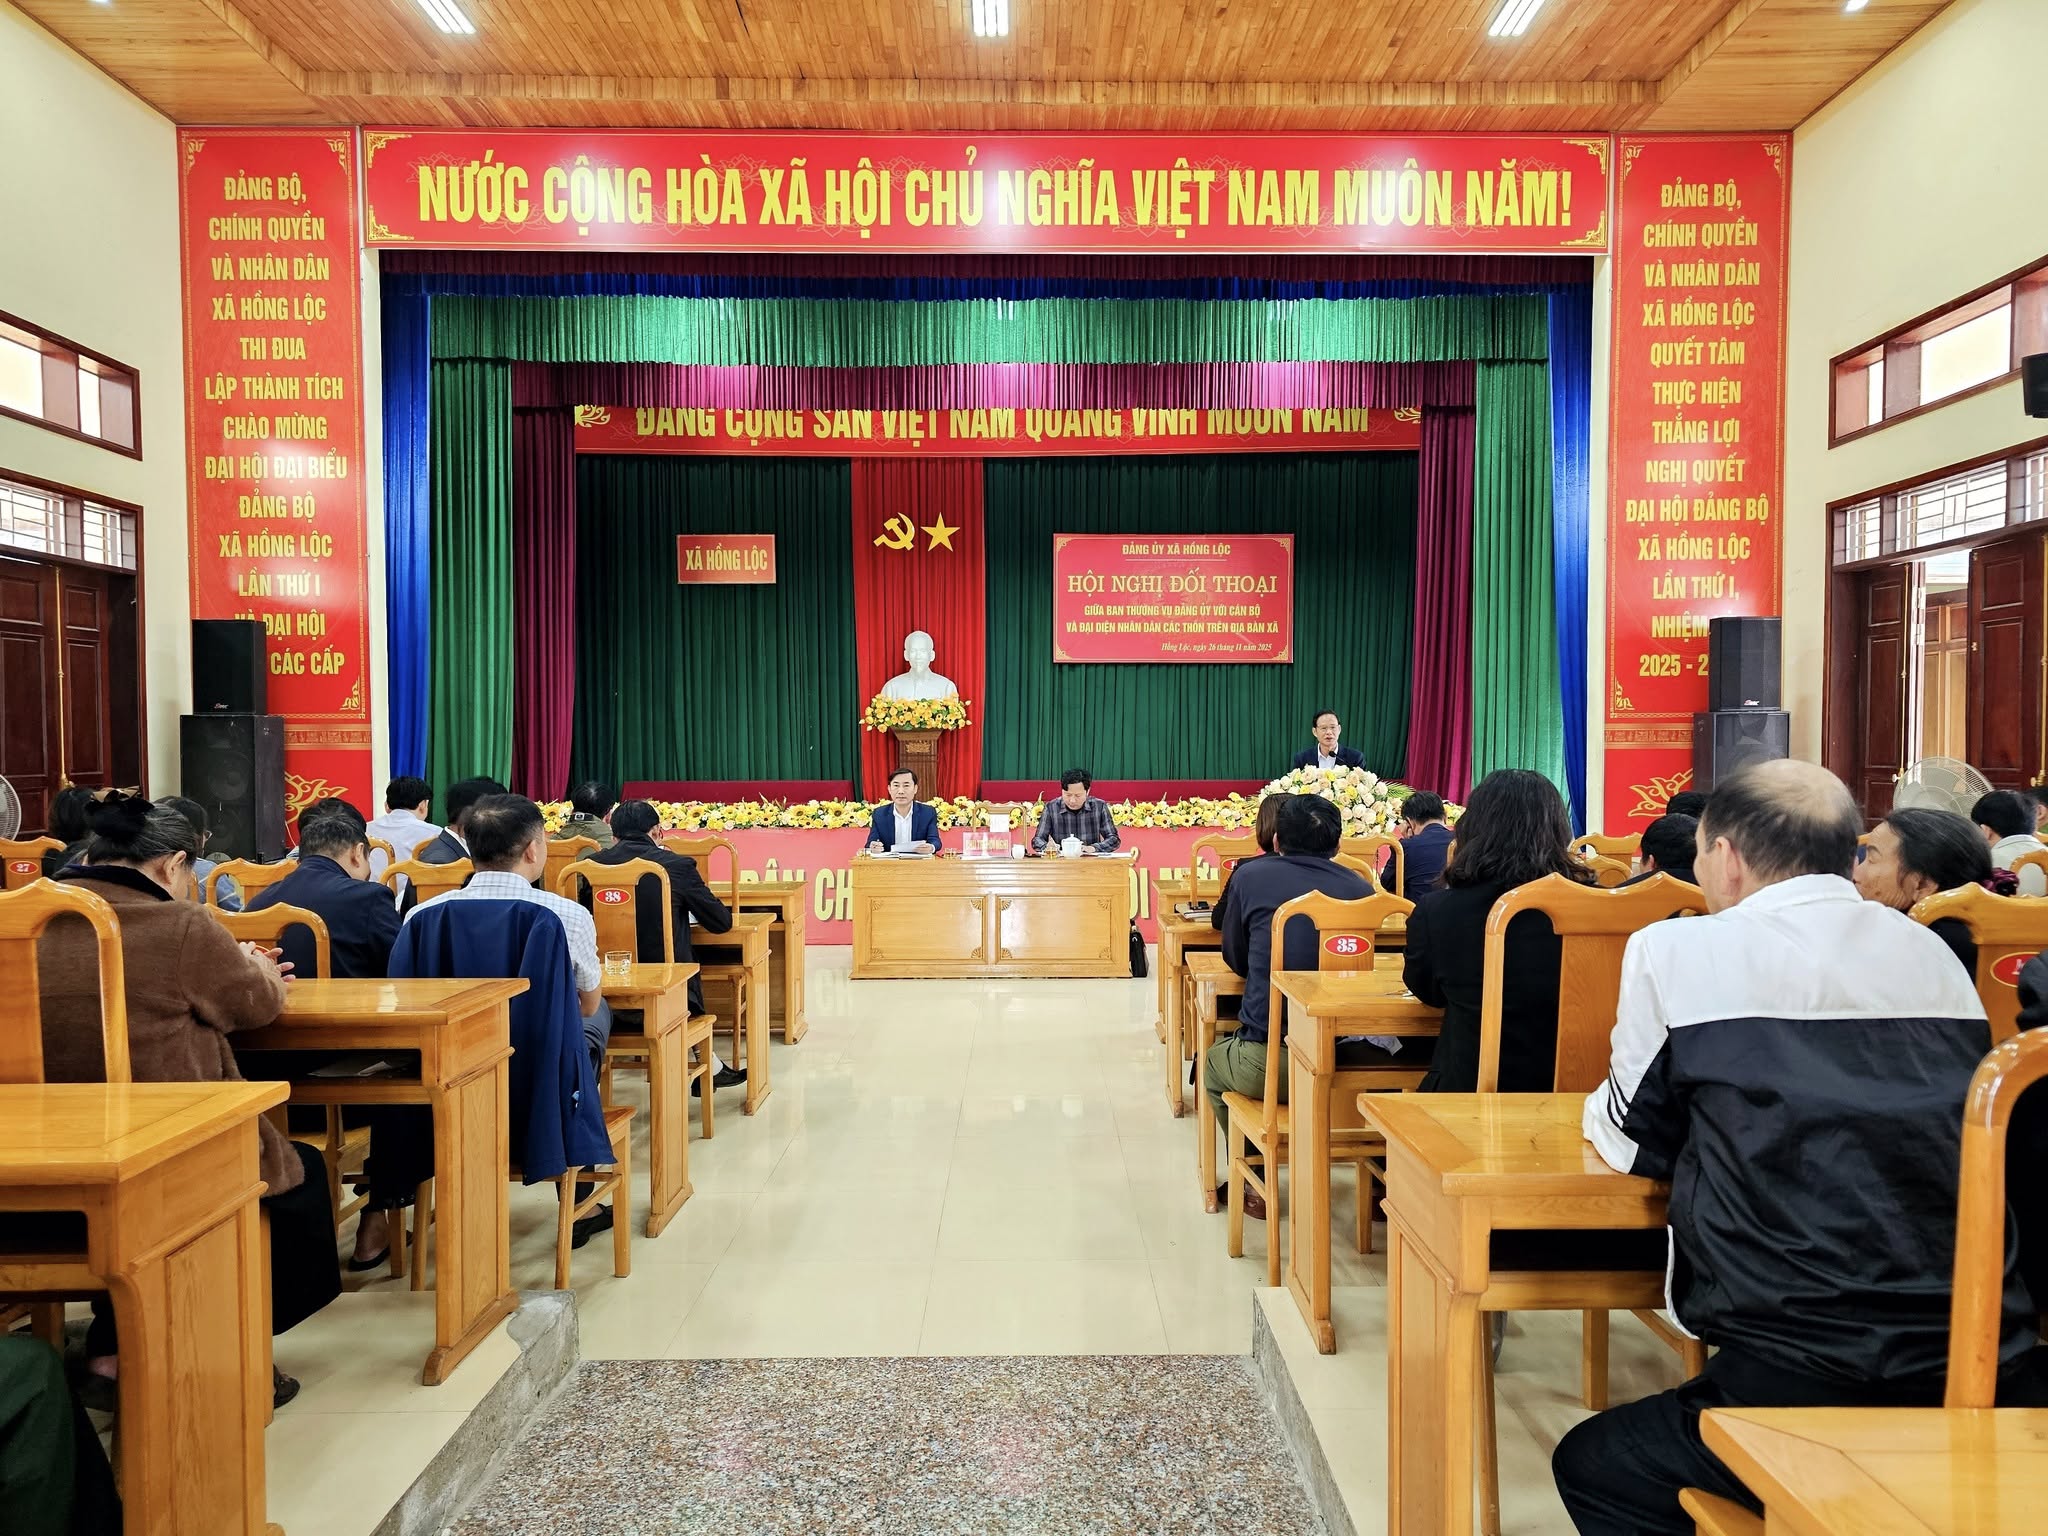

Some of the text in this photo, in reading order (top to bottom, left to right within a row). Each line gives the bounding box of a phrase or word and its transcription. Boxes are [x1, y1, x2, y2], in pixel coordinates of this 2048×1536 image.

[224, 169, 307, 205] ĐẢNG BỘ,
[419, 145, 1572, 239] NƯỚC CỘNG HÒA XÃ HỘI CHỦ NGHĨA VIỆT NAM MUÔN NĂM!
[1661, 176, 1742, 212] ĐẢNG BỘ,
[208, 210, 325, 243] CHÍNH QUYỀN
[1643, 215, 1758, 249] CHÍNH QUYỀN
[211, 253, 330, 281] VÀ NHÂN DÂN
[1644, 257, 1760, 287] VÀ NHÂN DÂN
[212, 290, 327, 325] XÃ HỒNG LỘC
[1642, 295, 1755, 330] XÃ HỒNG LỘC
[240, 337, 306, 360] THI ĐUA
[1650, 335, 1745, 368] QUYẾT TÂM
[205, 372, 344, 405] LẬP THÀNH TÍCH
[1652, 376, 1742, 409] THỰC HIỆN
[223, 412, 328, 440] CHÀO MỪNG
[949, 407, 1015, 440] NAM
[1025, 407, 1121, 443] QUANG
[1131, 407, 1198, 438] VINH
[1652, 412, 1740, 448] THẮNG LỢI
[205, 447, 348, 484] ĐẠI HỘI ĐẠI BIỂU
[1645, 452, 1745, 488] NGHỊ QUYẾT
[239, 488, 316, 523] ĐẢNG BỘ
[1625, 491, 1769, 527] ĐẠI HỘI ĐẢNG BỘ
[219, 527, 333, 562] XÃ HỒNG LỘC
[685, 542, 768, 575] XÃ HỒNG LỘC
[1122, 541, 1150, 555] ĐẢNG
[1152, 541, 1164, 555] ỦY
[1167, 542, 1180, 555] XÃ
[1212, 542, 1231, 557] LỘC
[1638, 530, 1751, 565] XÃ HỒNG LỘC
[238, 567, 321, 597] LẦN THỨ I
[1067, 566, 1278, 598] HỘI NGHỊ ĐỐI THOẠI
[1652, 569, 1739, 601] LẦN THỨ I,
[262, 609, 326, 640] ĐẠI HỘI
[1084, 603, 1104, 616] GIỮA
[1106, 605, 1124, 616] BAN
[1175, 603, 1198, 616] ĐẢNG
[1200, 603, 1211, 616] ỦY
[1213, 603, 1227, 616] VỚI
[1229, 603, 1247, 616] CÁN
[1249, 603, 1261, 618] BỘ
[1651, 611, 1708, 642] NHIỆM
[1066, 620, 1078, 633] VÀ
[1079, 622, 1094, 635] ĐẠI
[1095, 620, 1115, 635] DIỆN
[1117, 620, 1141, 633] NHÂN
[1143, 620, 1161, 633] DÂN
[1163, 620, 1181, 633] CÁC
[1182, 620, 1204, 633] THÔN
[1206, 620, 1228, 633] TRÊN
[1247, 620, 1265, 633] BÀN
[1267, 620, 1279, 633] XÃ
[270, 644, 345, 675] CÁC CẤP
[1639, 654, 1681, 677] 2025
[16, 863, 30, 873] 27
[605, 891, 621, 903] 38
[1336, 938, 1358, 953] 35
